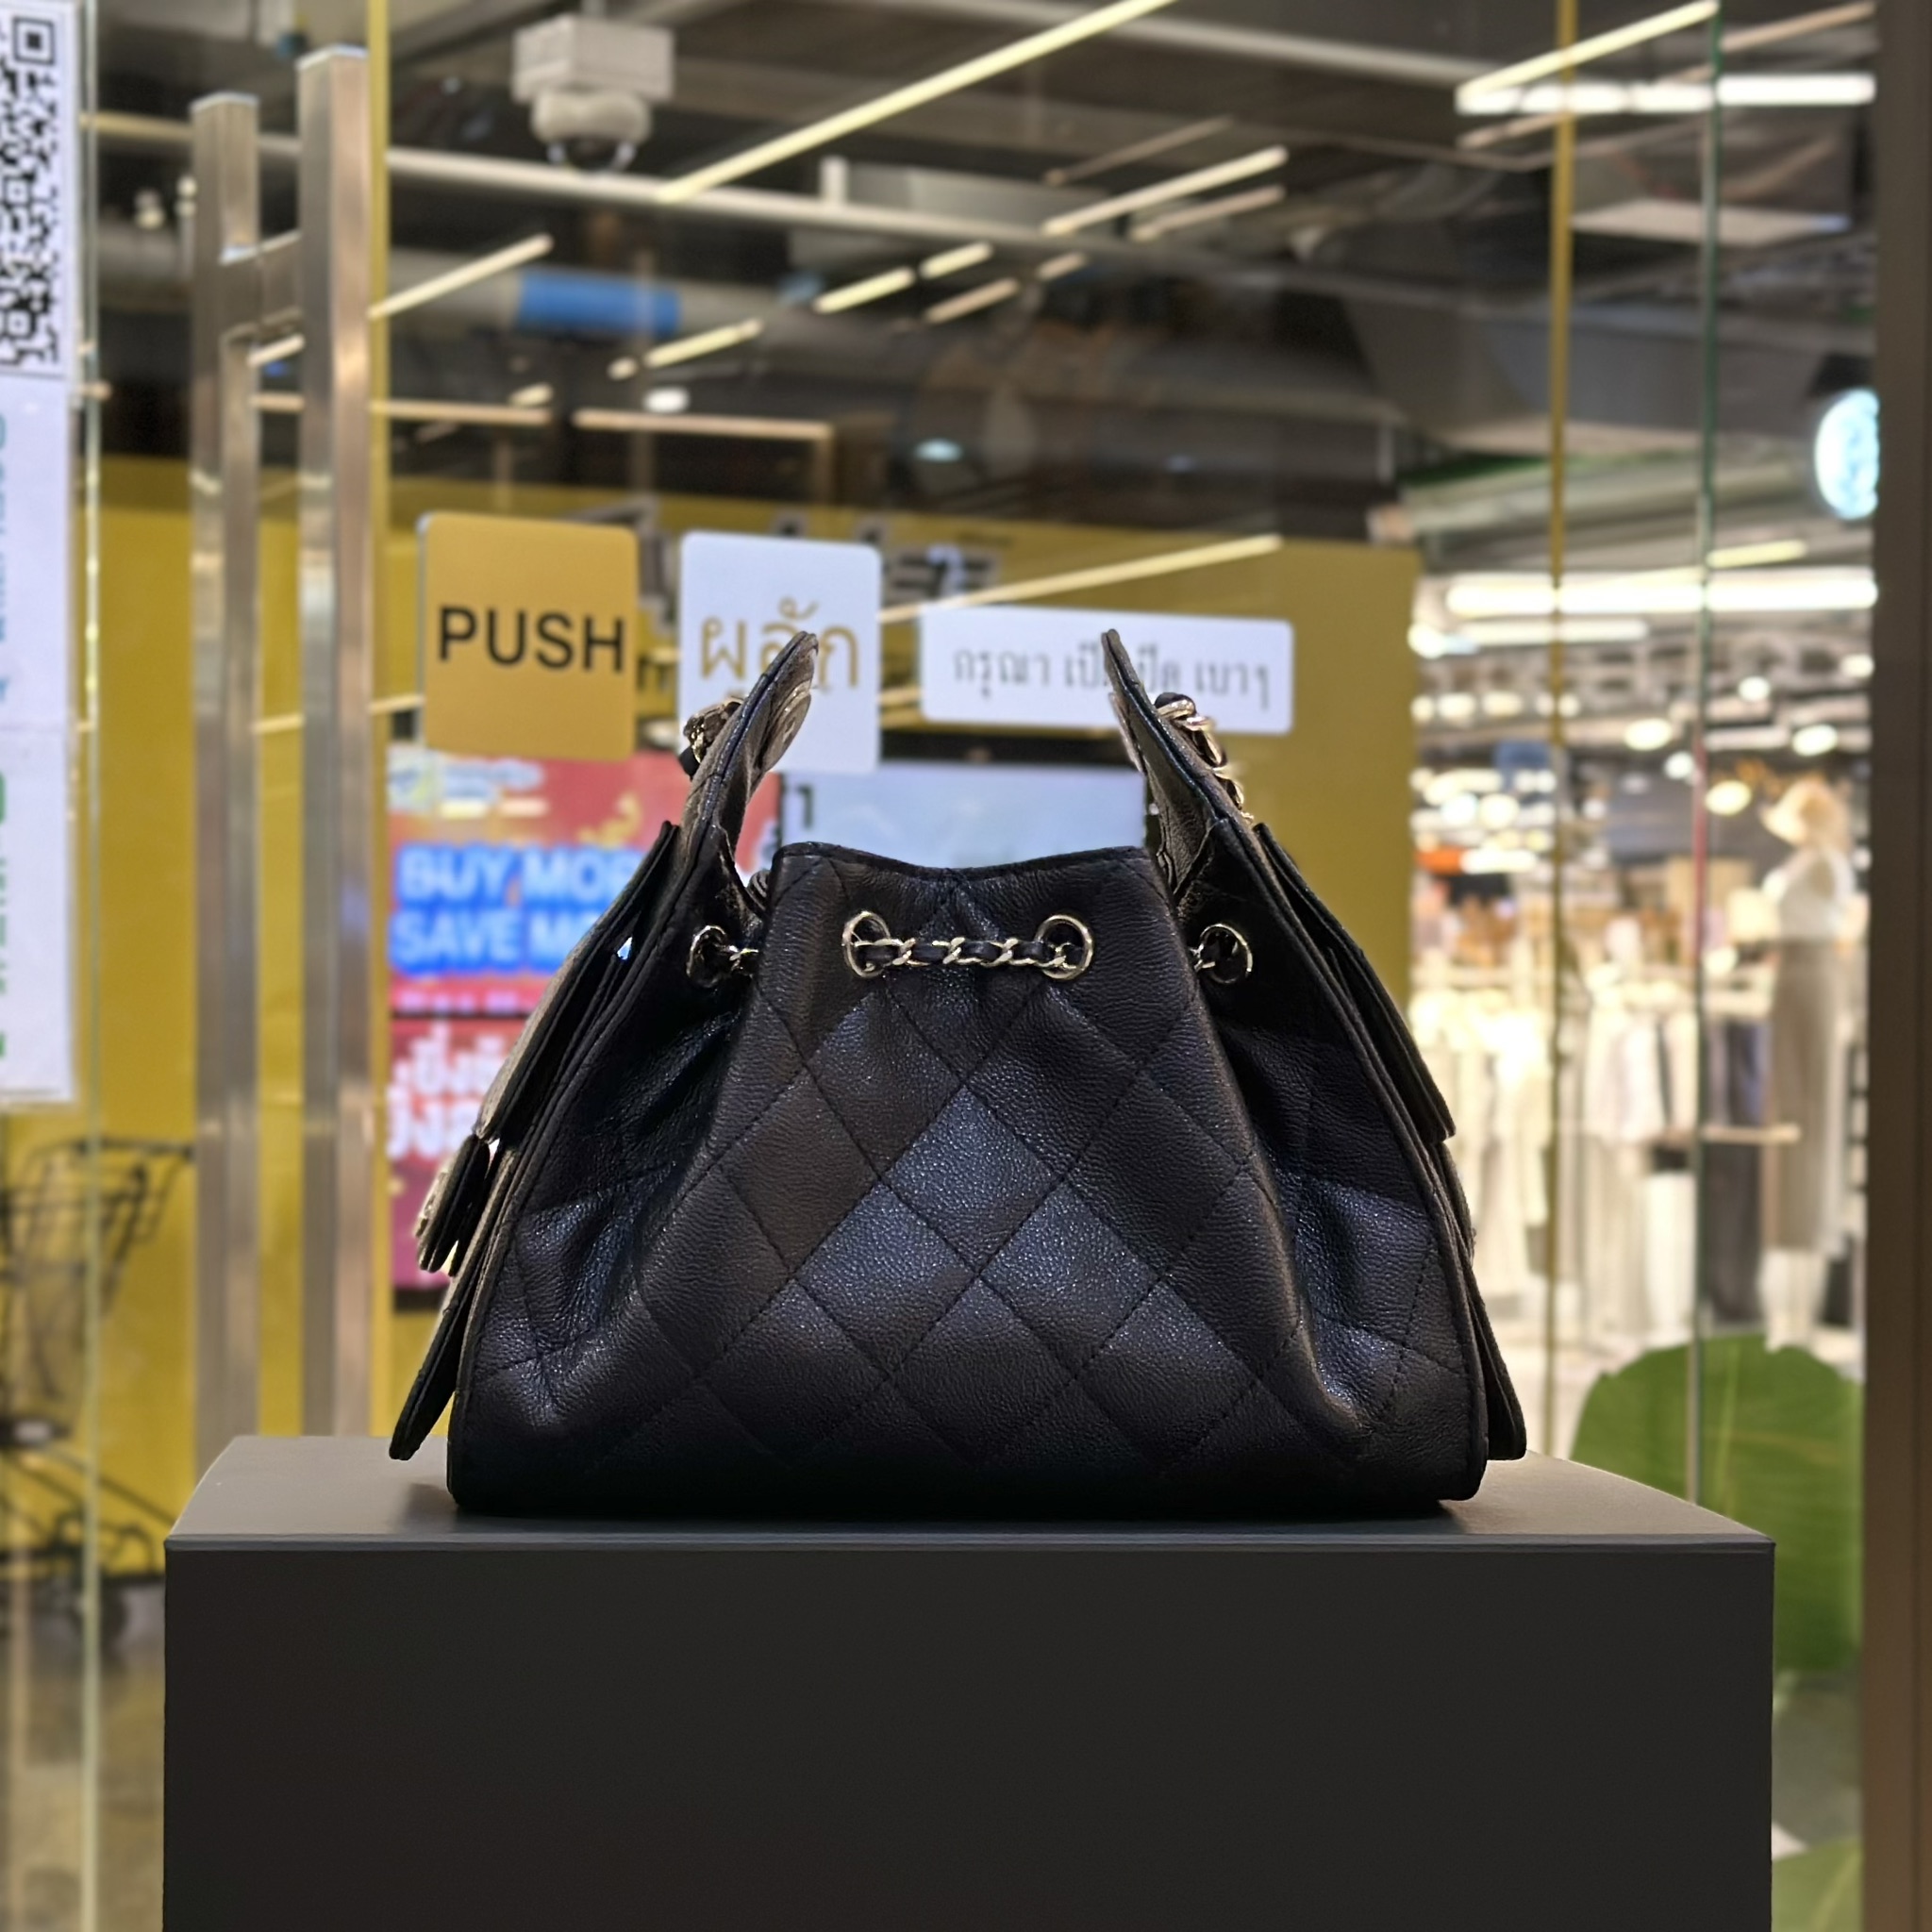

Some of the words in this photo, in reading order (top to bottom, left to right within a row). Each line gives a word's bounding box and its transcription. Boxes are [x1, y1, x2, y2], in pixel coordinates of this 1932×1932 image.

[438, 604, 625, 673] PUSH
[953, 647, 1051, 699] กรุณา
[399, 846, 512, 900] BUY
[391, 909, 521, 964] SAVE
